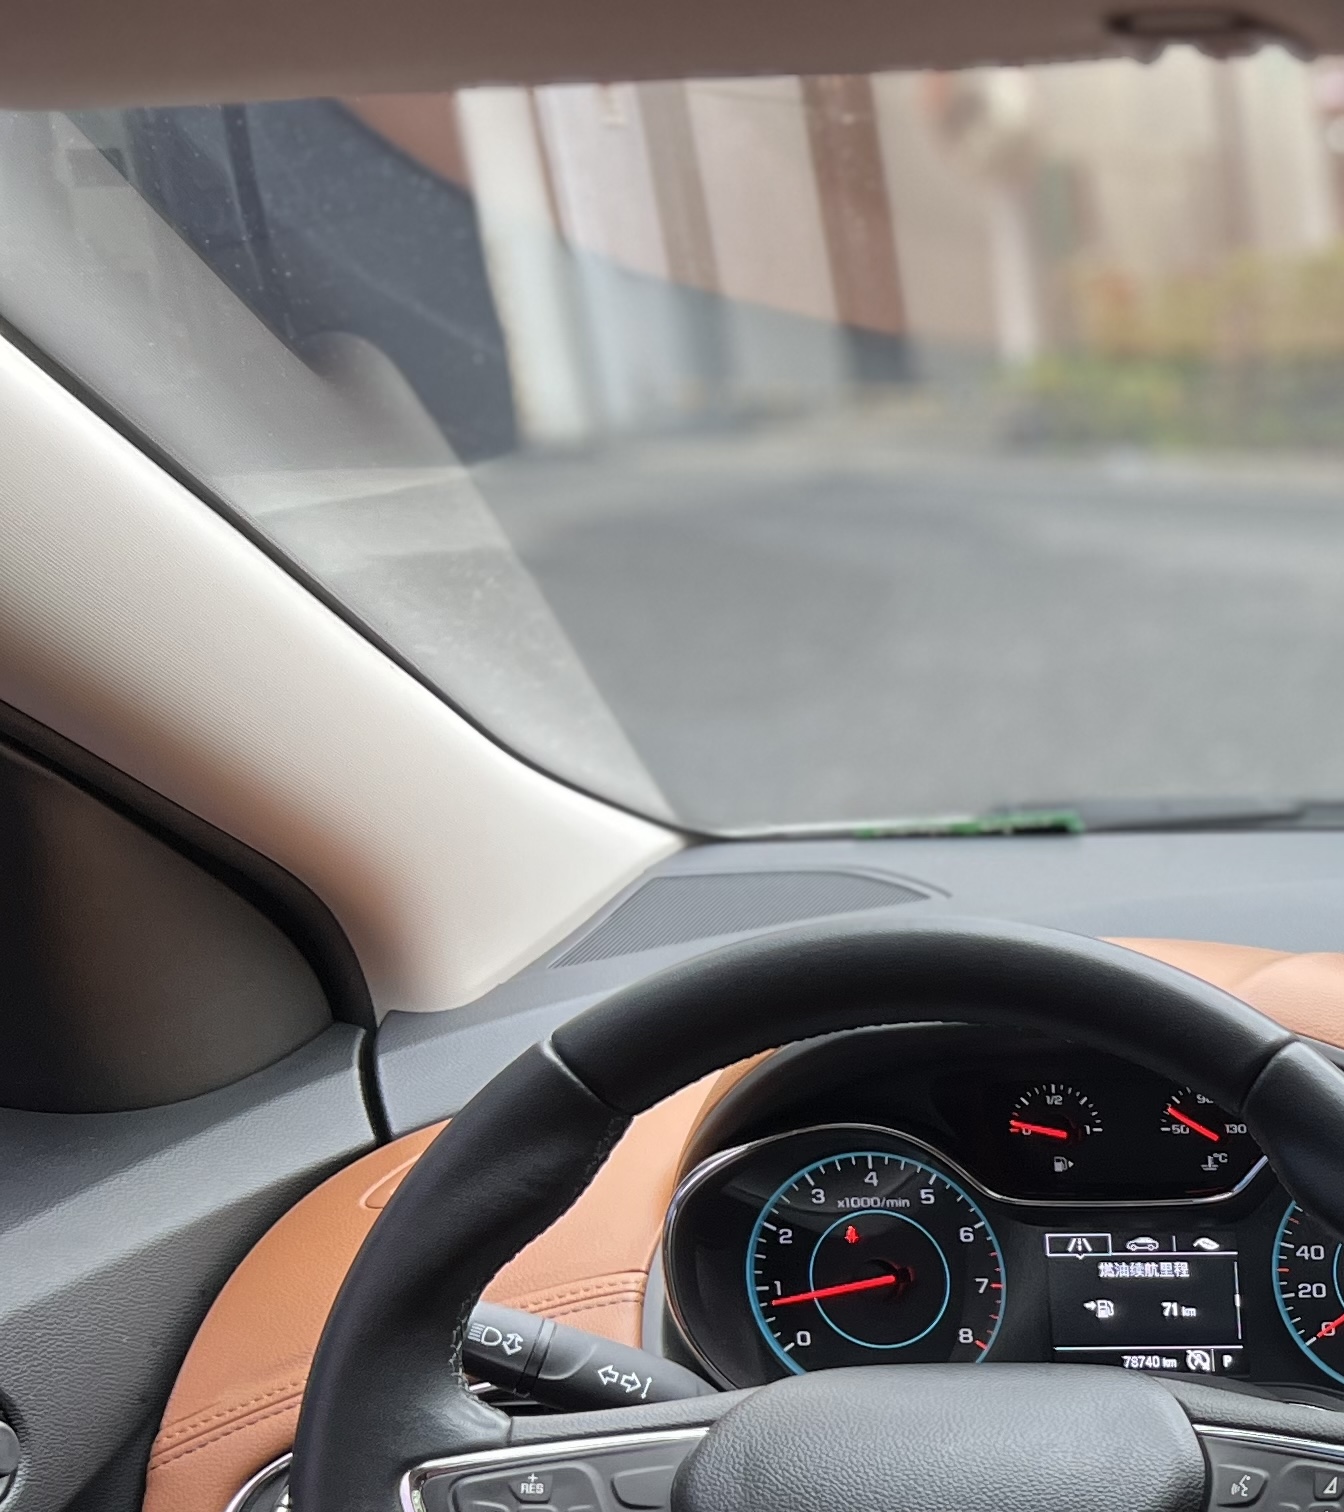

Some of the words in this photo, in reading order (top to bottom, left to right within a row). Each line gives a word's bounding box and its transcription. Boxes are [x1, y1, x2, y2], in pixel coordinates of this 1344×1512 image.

[1045, 1095, 1063, 1106] 1/2
[1171, 1124, 1190, 1135] 50
[1225, 1124, 1247, 1135] 130
[864, 1171, 879, 1187] 4
[811, 1188, 826, 1204] 3
[837, 1197, 911, 1209] x1000/min
[920, 1189, 935, 1205] 5
[778, 1228, 793, 1244] 2
[959, 1227, 975, 1243] 6
[1295, 1245, 1325, 1261] 40
[1097, 1261, 1190, 1278] 燃油续航里程
[774, 1280, 782, 1296] 1
[974, 1278, 989, 1294] 7
[1298, 1283, 1327, 1299] 20
[1160, 1302, 1179, 1317] 71
[1181, 1305, 1197, 1317] km
[958, 1328, 974, 1344] 8
[1321, 1321, 1336, 1337] 0
[796, 1330, 811, 1347] 0
[1162, 1356, 1178, 1369] km
[1222, 1354, 1233, 1368] P
[520, 1483, 544, 1494] RES
